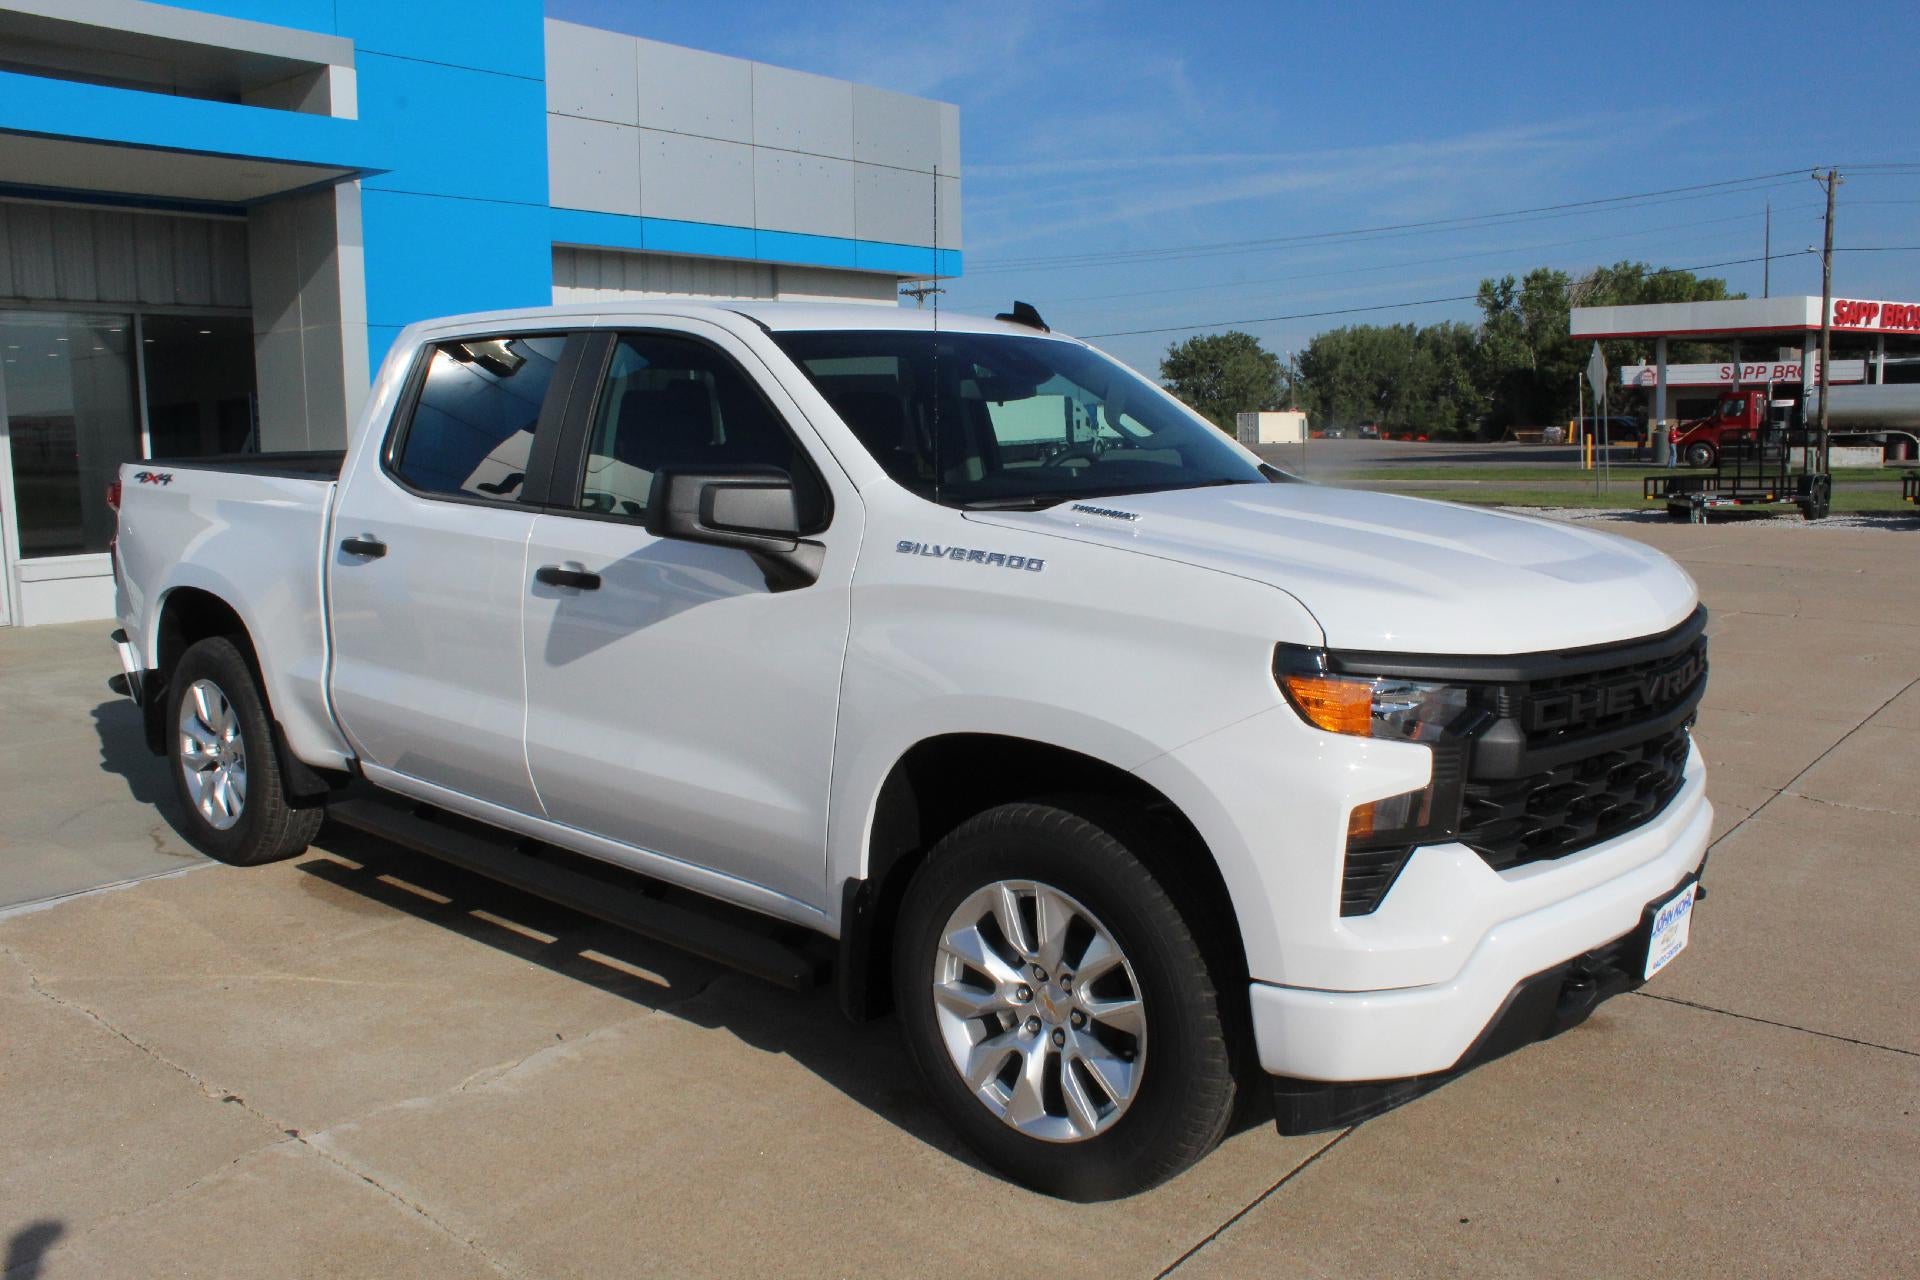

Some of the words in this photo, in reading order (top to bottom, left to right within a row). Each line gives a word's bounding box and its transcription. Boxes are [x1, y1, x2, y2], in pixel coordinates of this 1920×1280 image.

[1833, 300, 1879, 326] SAPP
[896, 540, 1047, 572] SILVERADO
[1523, 654, 1702, 732] CHEVRO
